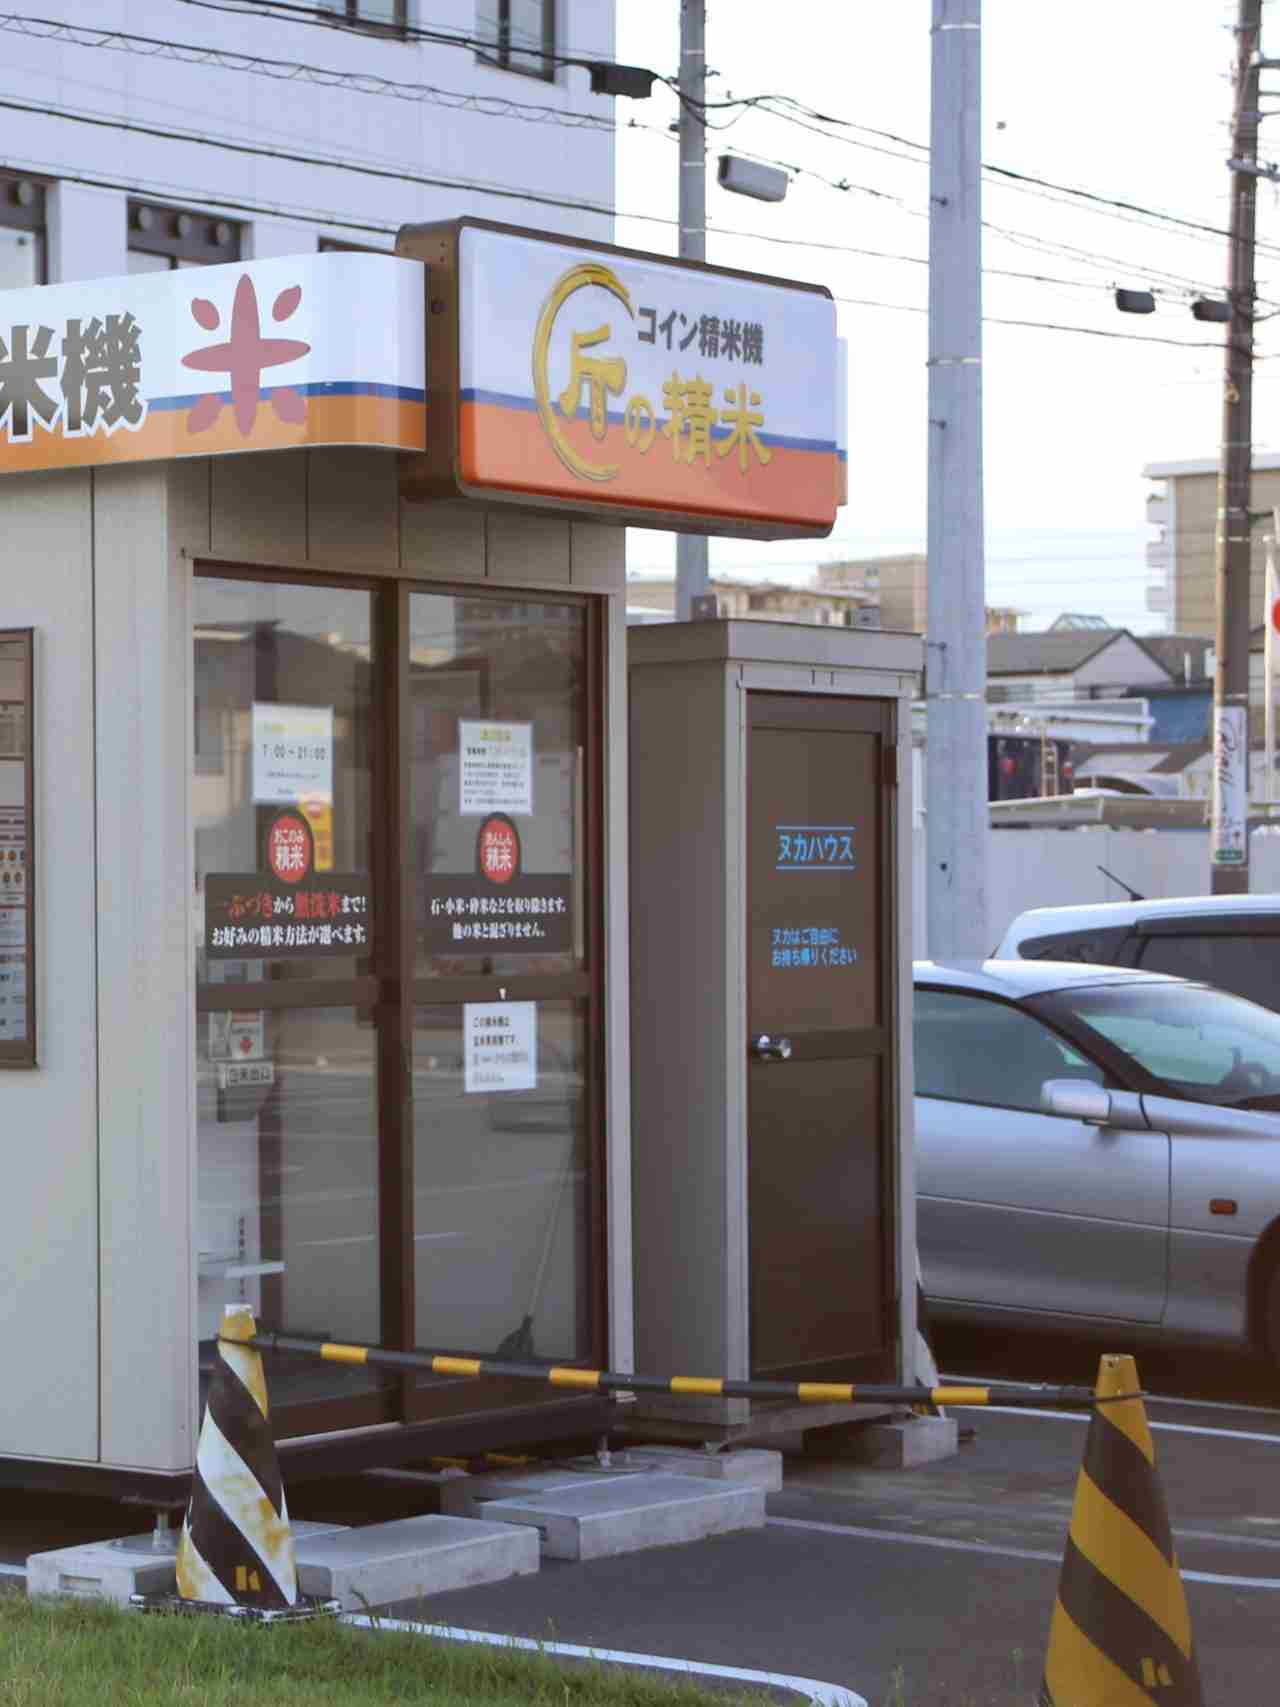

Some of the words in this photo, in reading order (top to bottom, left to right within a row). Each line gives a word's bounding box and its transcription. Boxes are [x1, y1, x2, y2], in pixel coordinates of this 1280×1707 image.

[637, 305, 764, 366] コイン精米機
[778, 833, 853, 863] ヌカハウス
